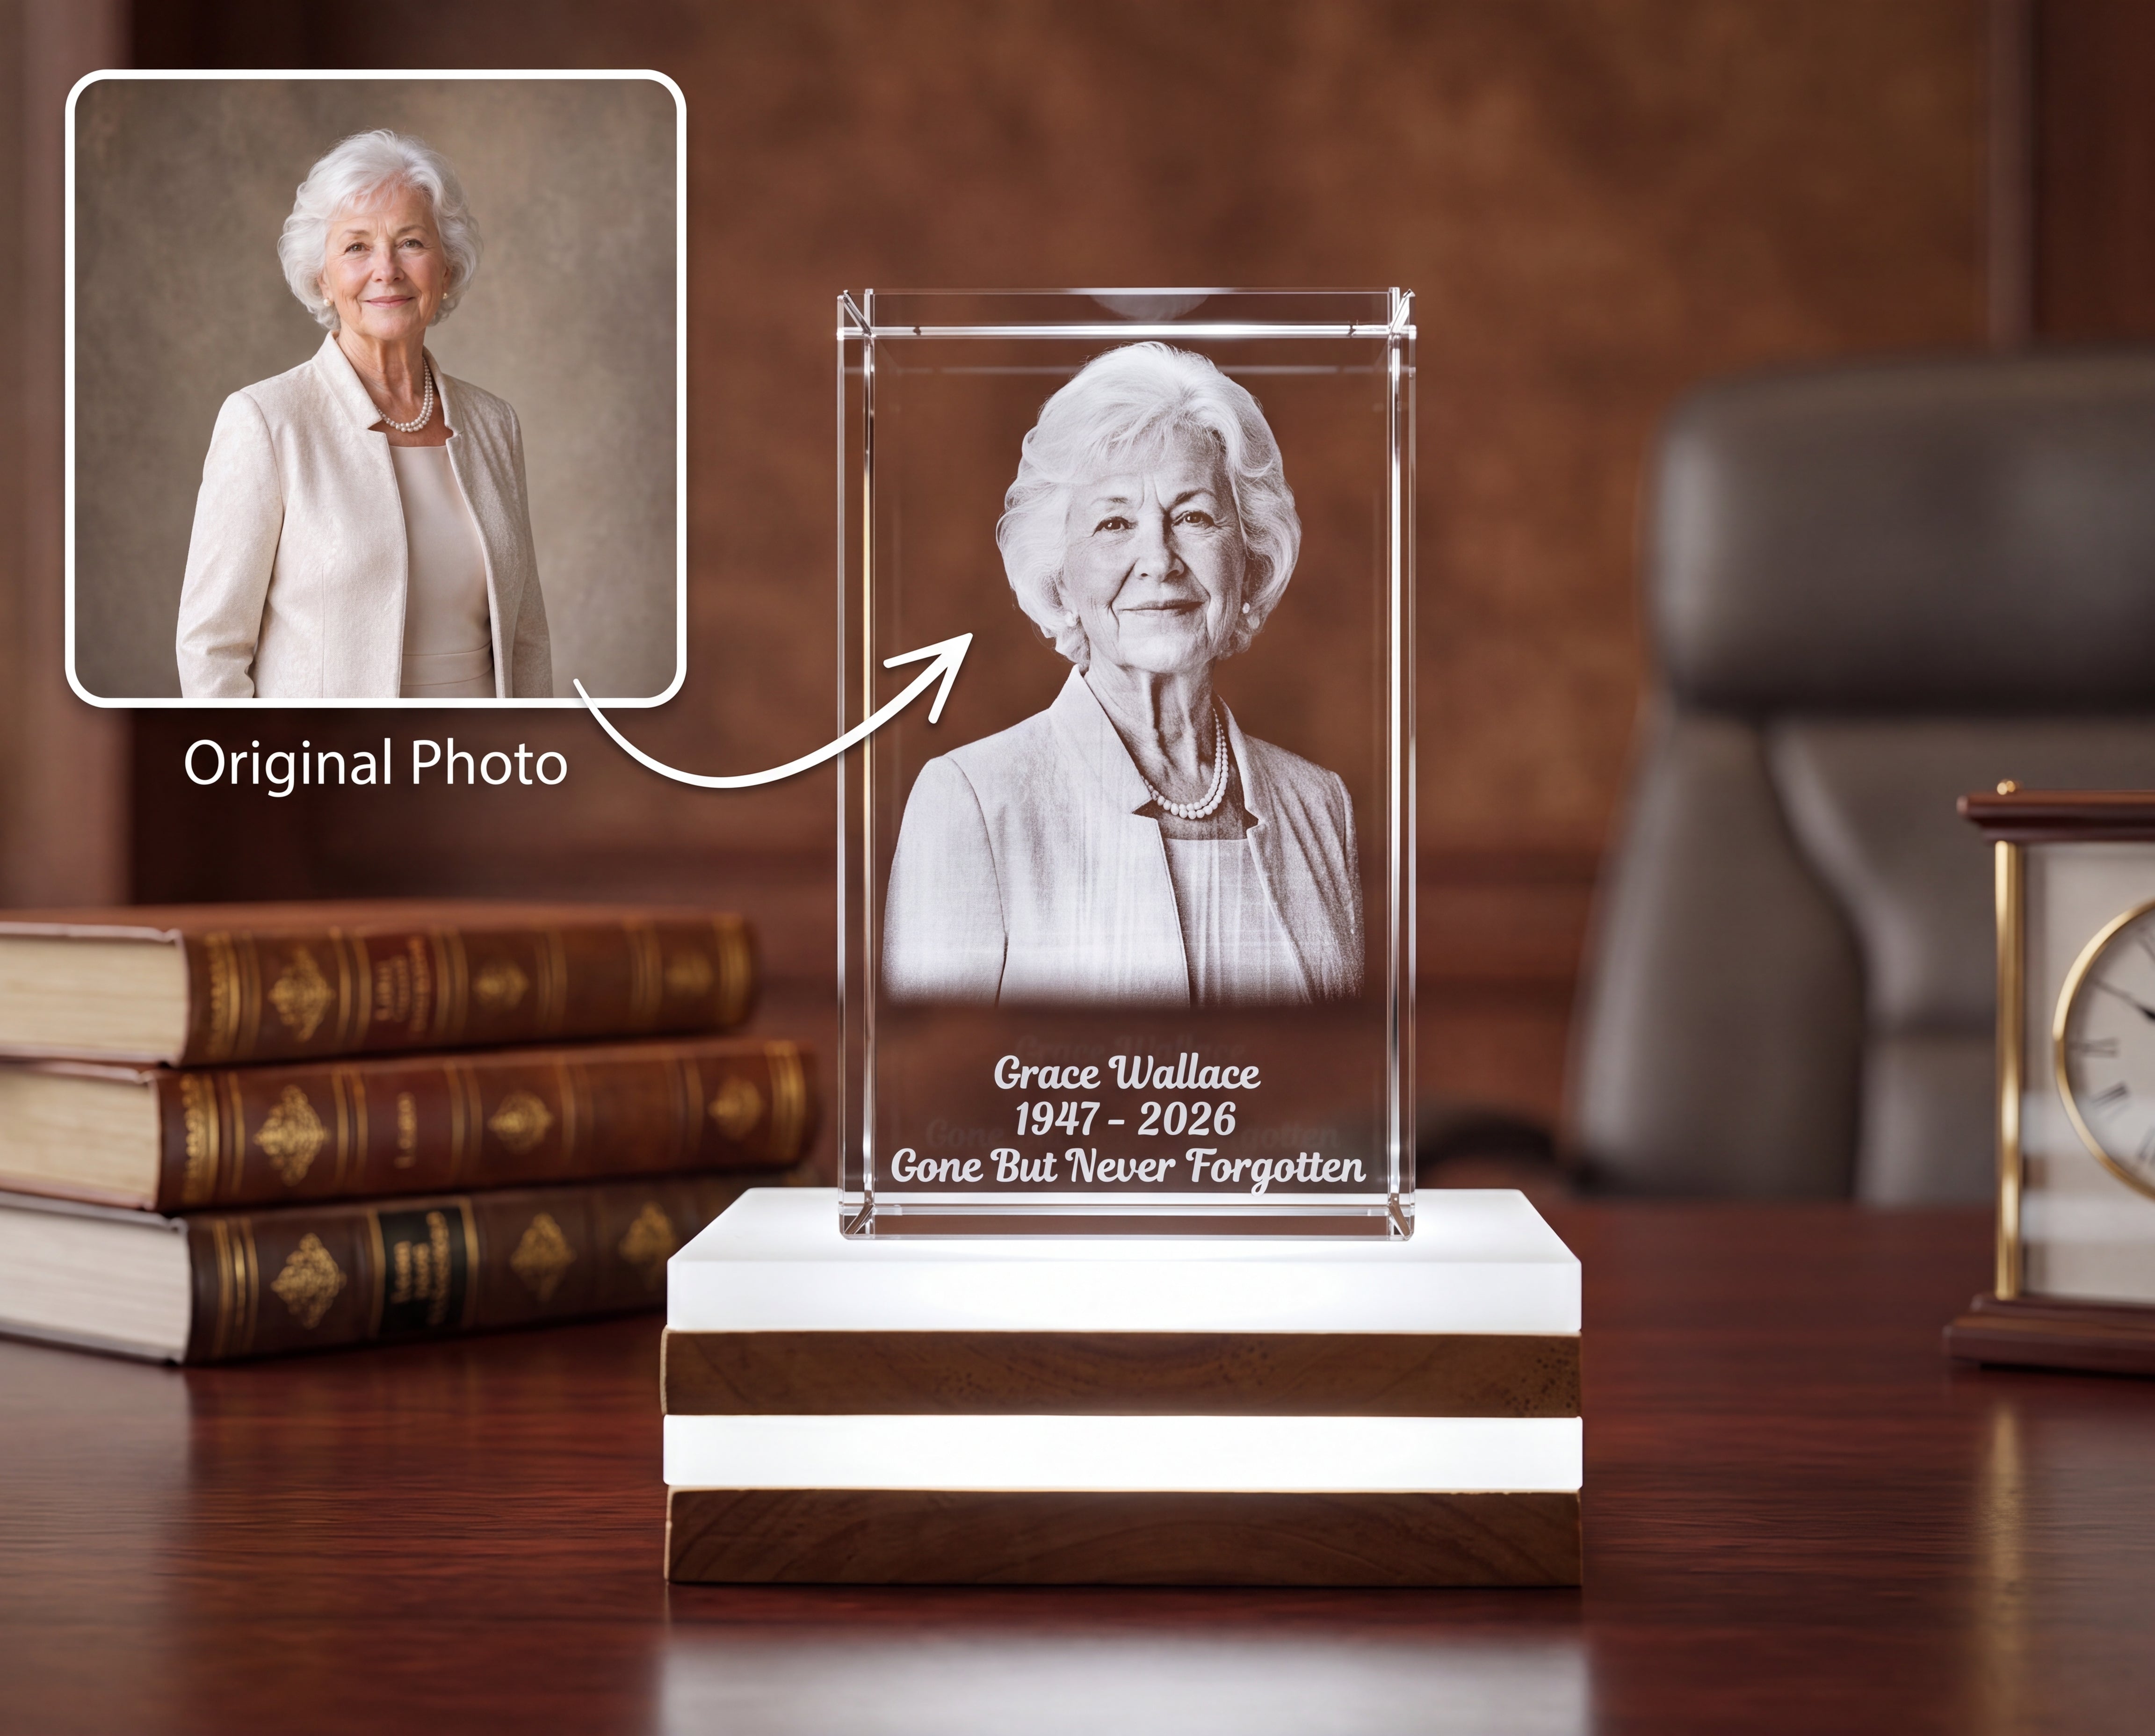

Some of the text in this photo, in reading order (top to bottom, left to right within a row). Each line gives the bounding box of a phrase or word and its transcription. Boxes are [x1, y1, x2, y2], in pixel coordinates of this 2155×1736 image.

[994, 1052, 1261, 1089] Grace Wallace
[1017, 1101, 1100, 1136] 1947
[1138, 1101, 1236, 1136] 2026
[891, 1148, 1367, 1196] Gone But Never Forgotten
